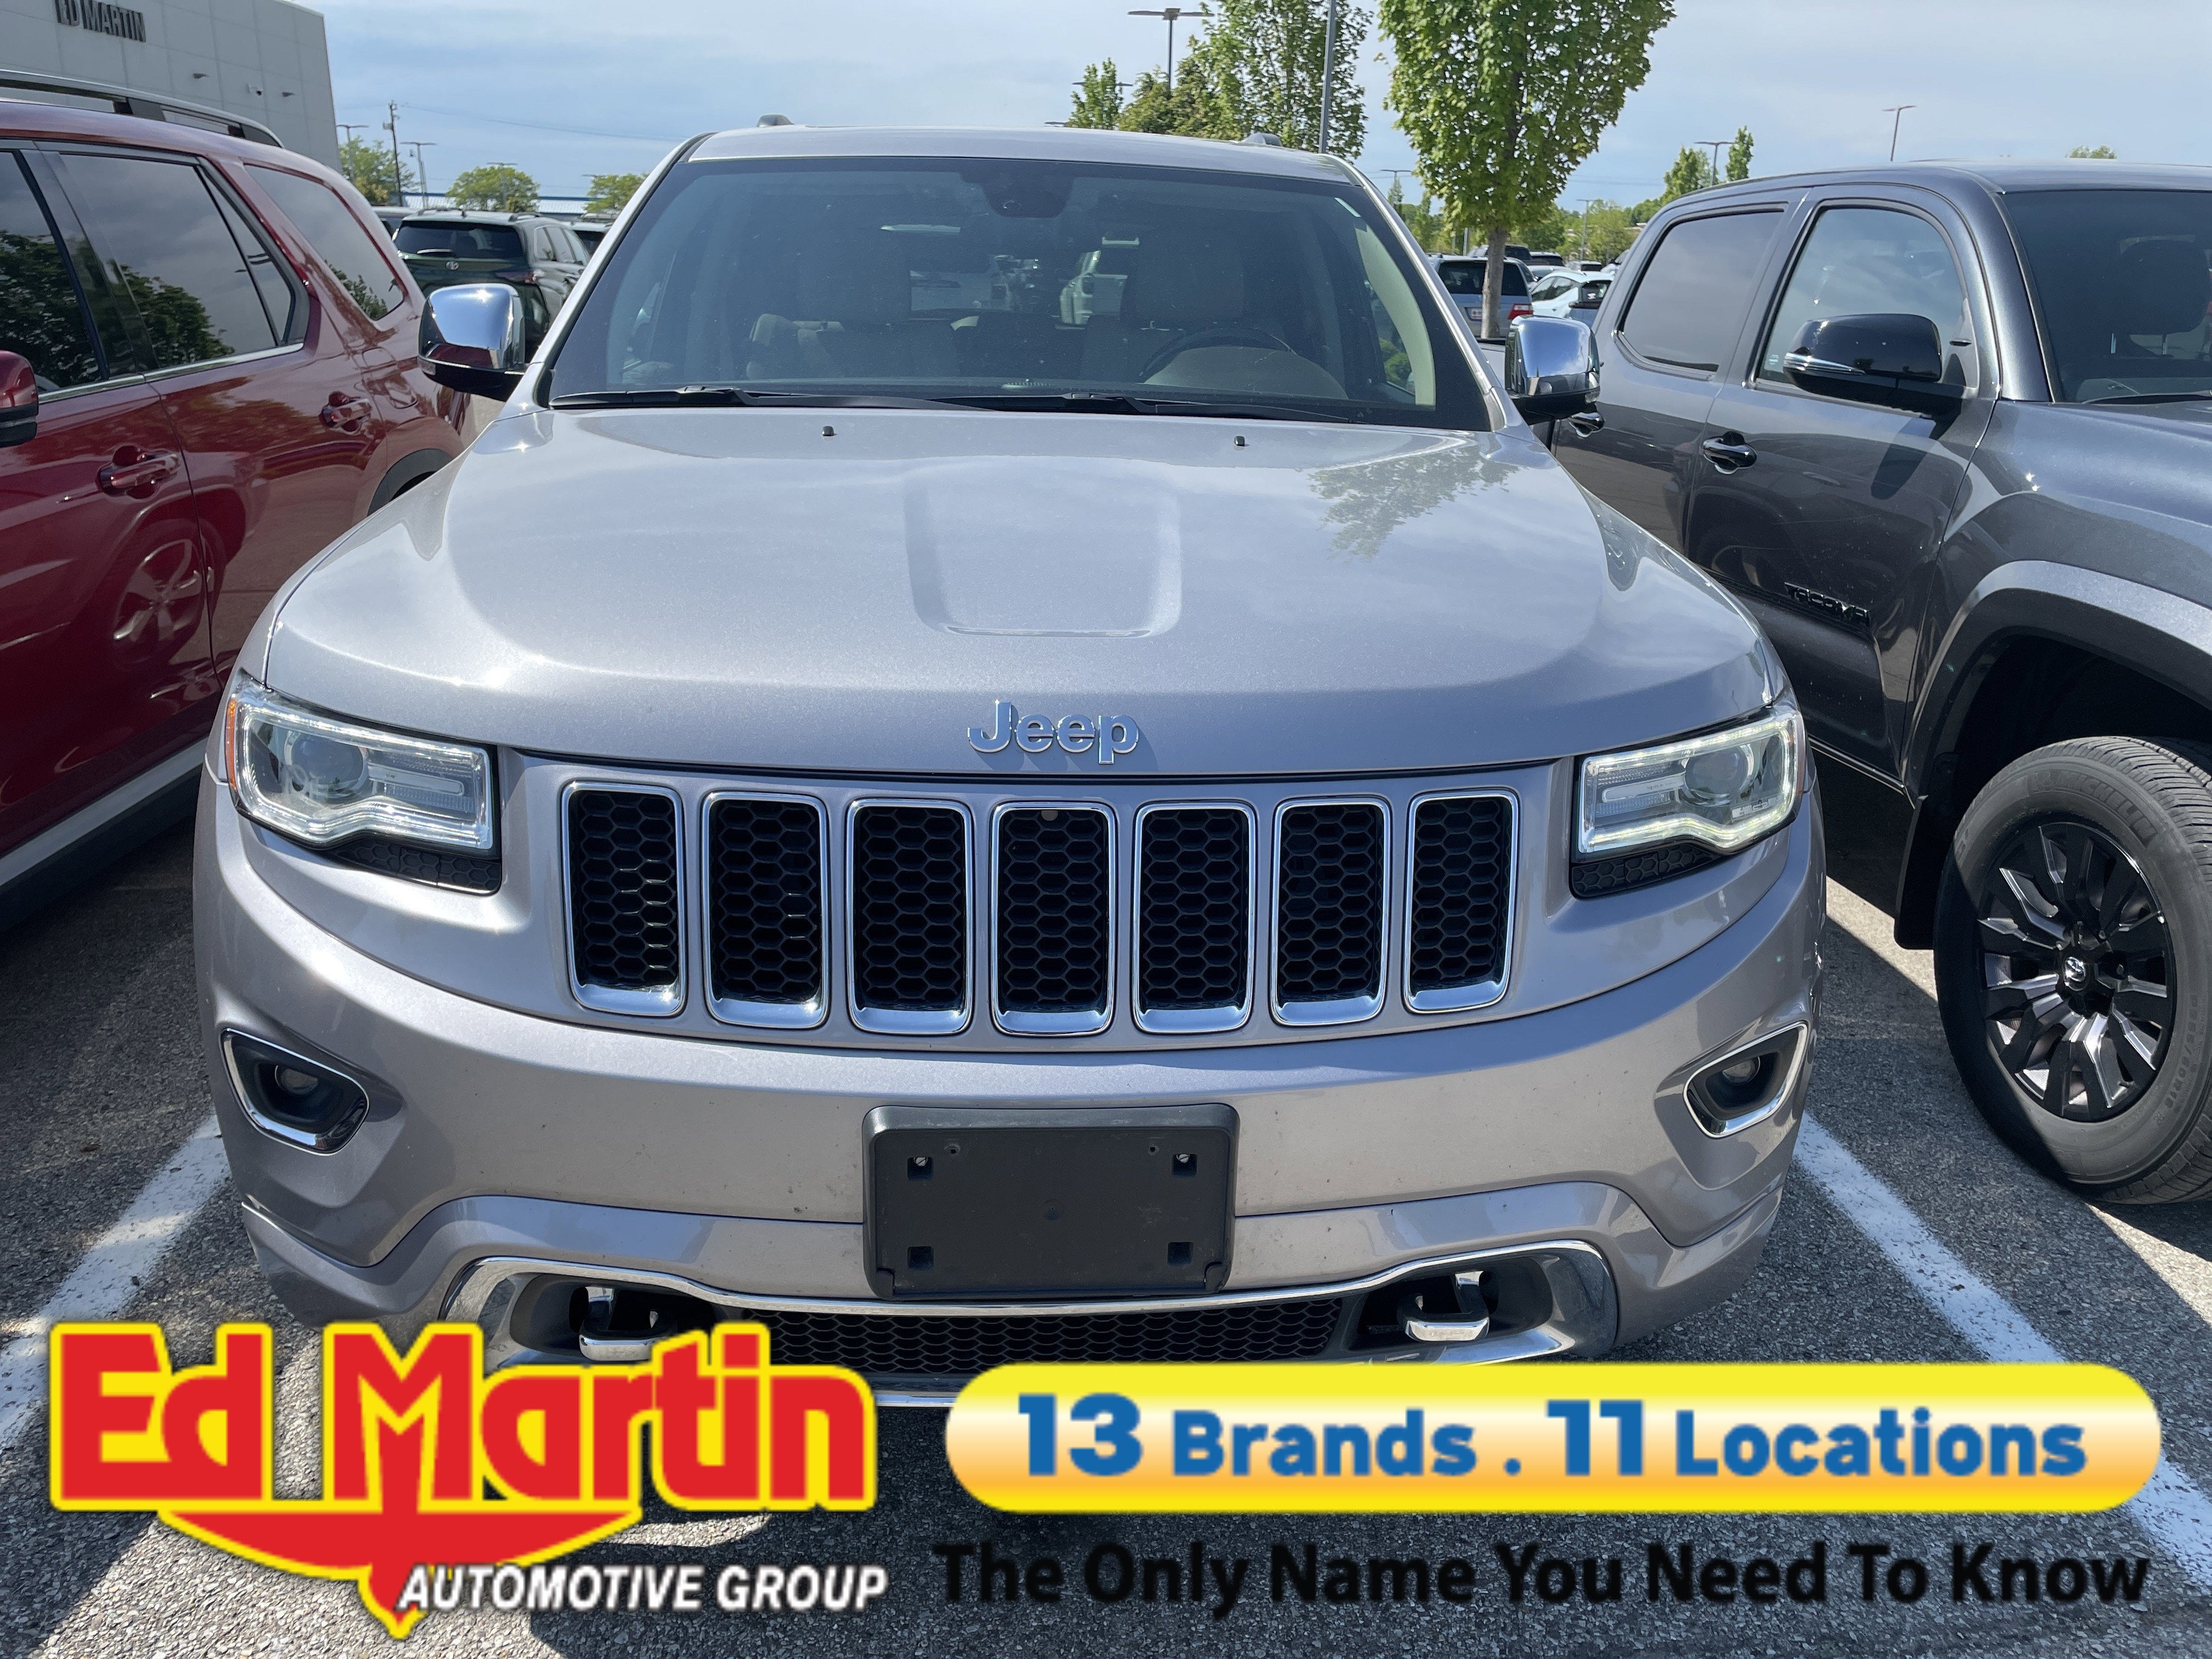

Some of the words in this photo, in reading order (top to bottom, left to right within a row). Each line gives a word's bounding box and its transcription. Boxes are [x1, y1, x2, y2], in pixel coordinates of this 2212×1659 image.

[81, 0, 146, 43] MARTIN
[967, 699, 1139, 764] Jeep
[2057, 770, 2158, 843] MICHELIN
